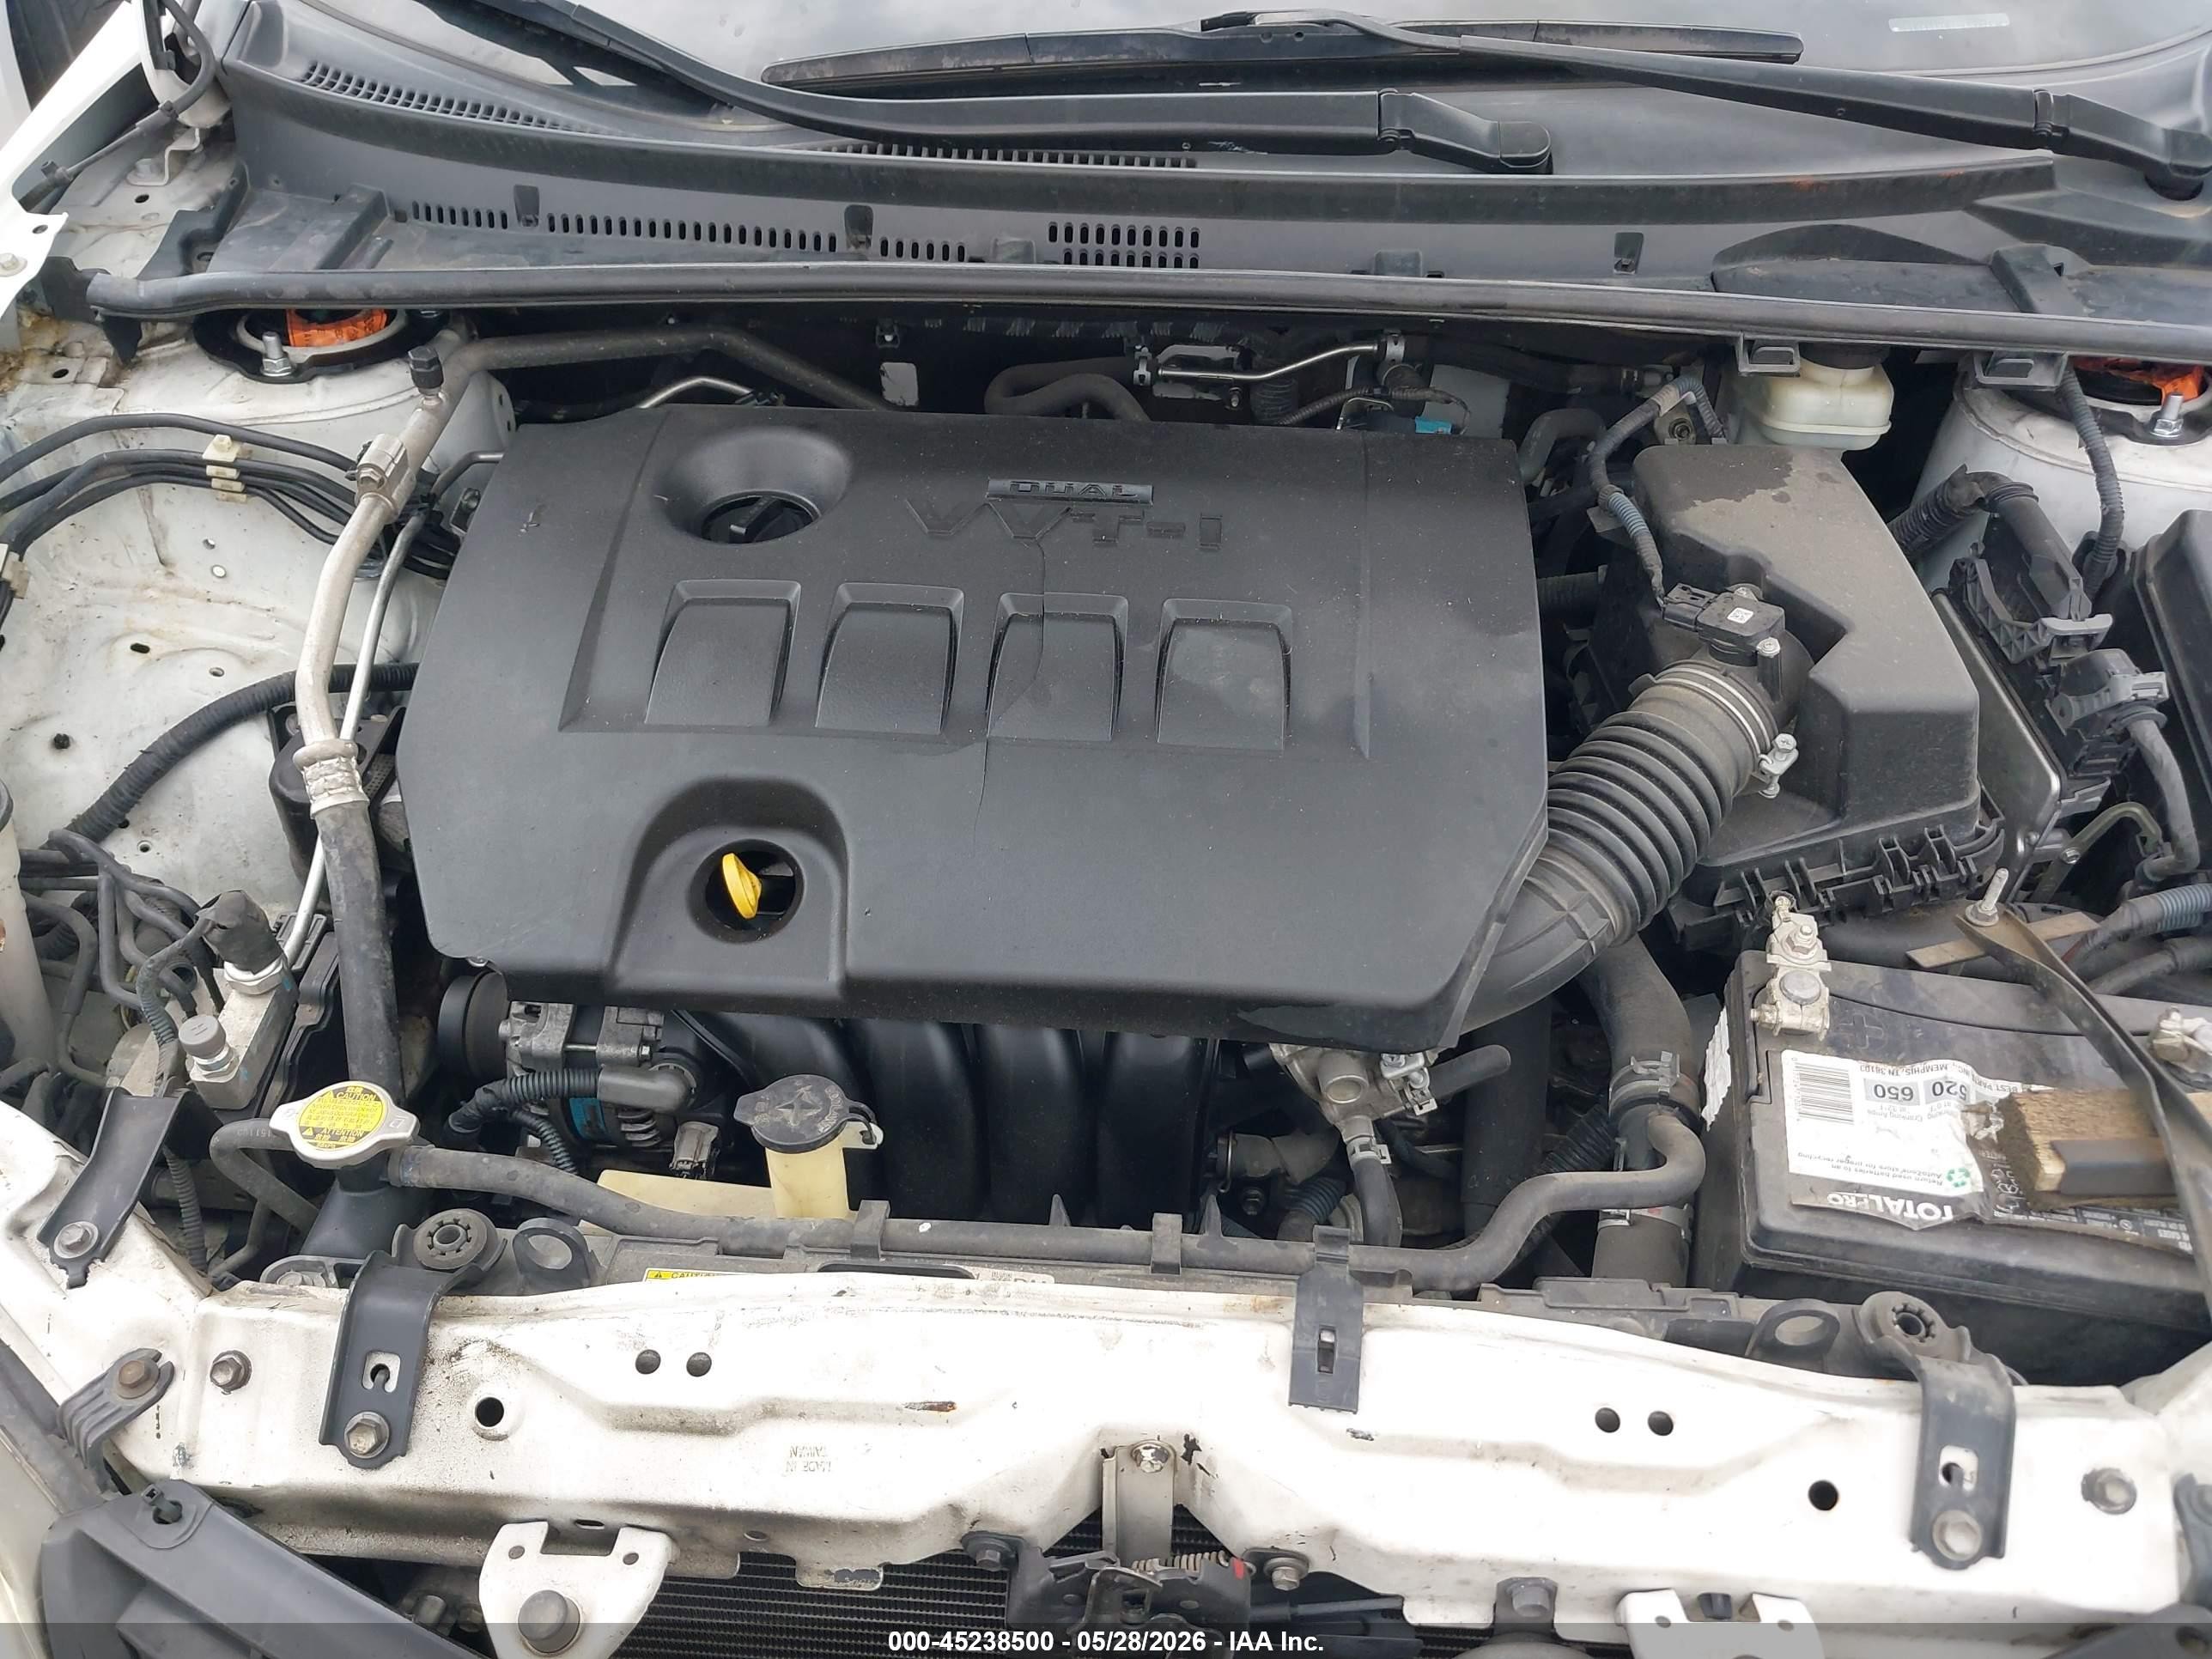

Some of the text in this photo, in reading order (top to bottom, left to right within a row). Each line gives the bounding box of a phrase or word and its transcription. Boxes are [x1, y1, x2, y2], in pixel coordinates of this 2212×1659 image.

[1008, 480, 1139, 497] DUAL
[1874, 1079, 1967, 1102] 520 650
[336, 1091, 377, 1101] CAUTION
[320, 1127, 365, 1137] ATTENTION
[1854, 1167, 1890, 1178] batteries
[1878, 1164, 1899, 1173] store
[1892, 1173, 1912, 1182] used
[1914, 1177, 1943, 1187] Return
[1826, 1193, 1954, 1220] TOTALPRO
